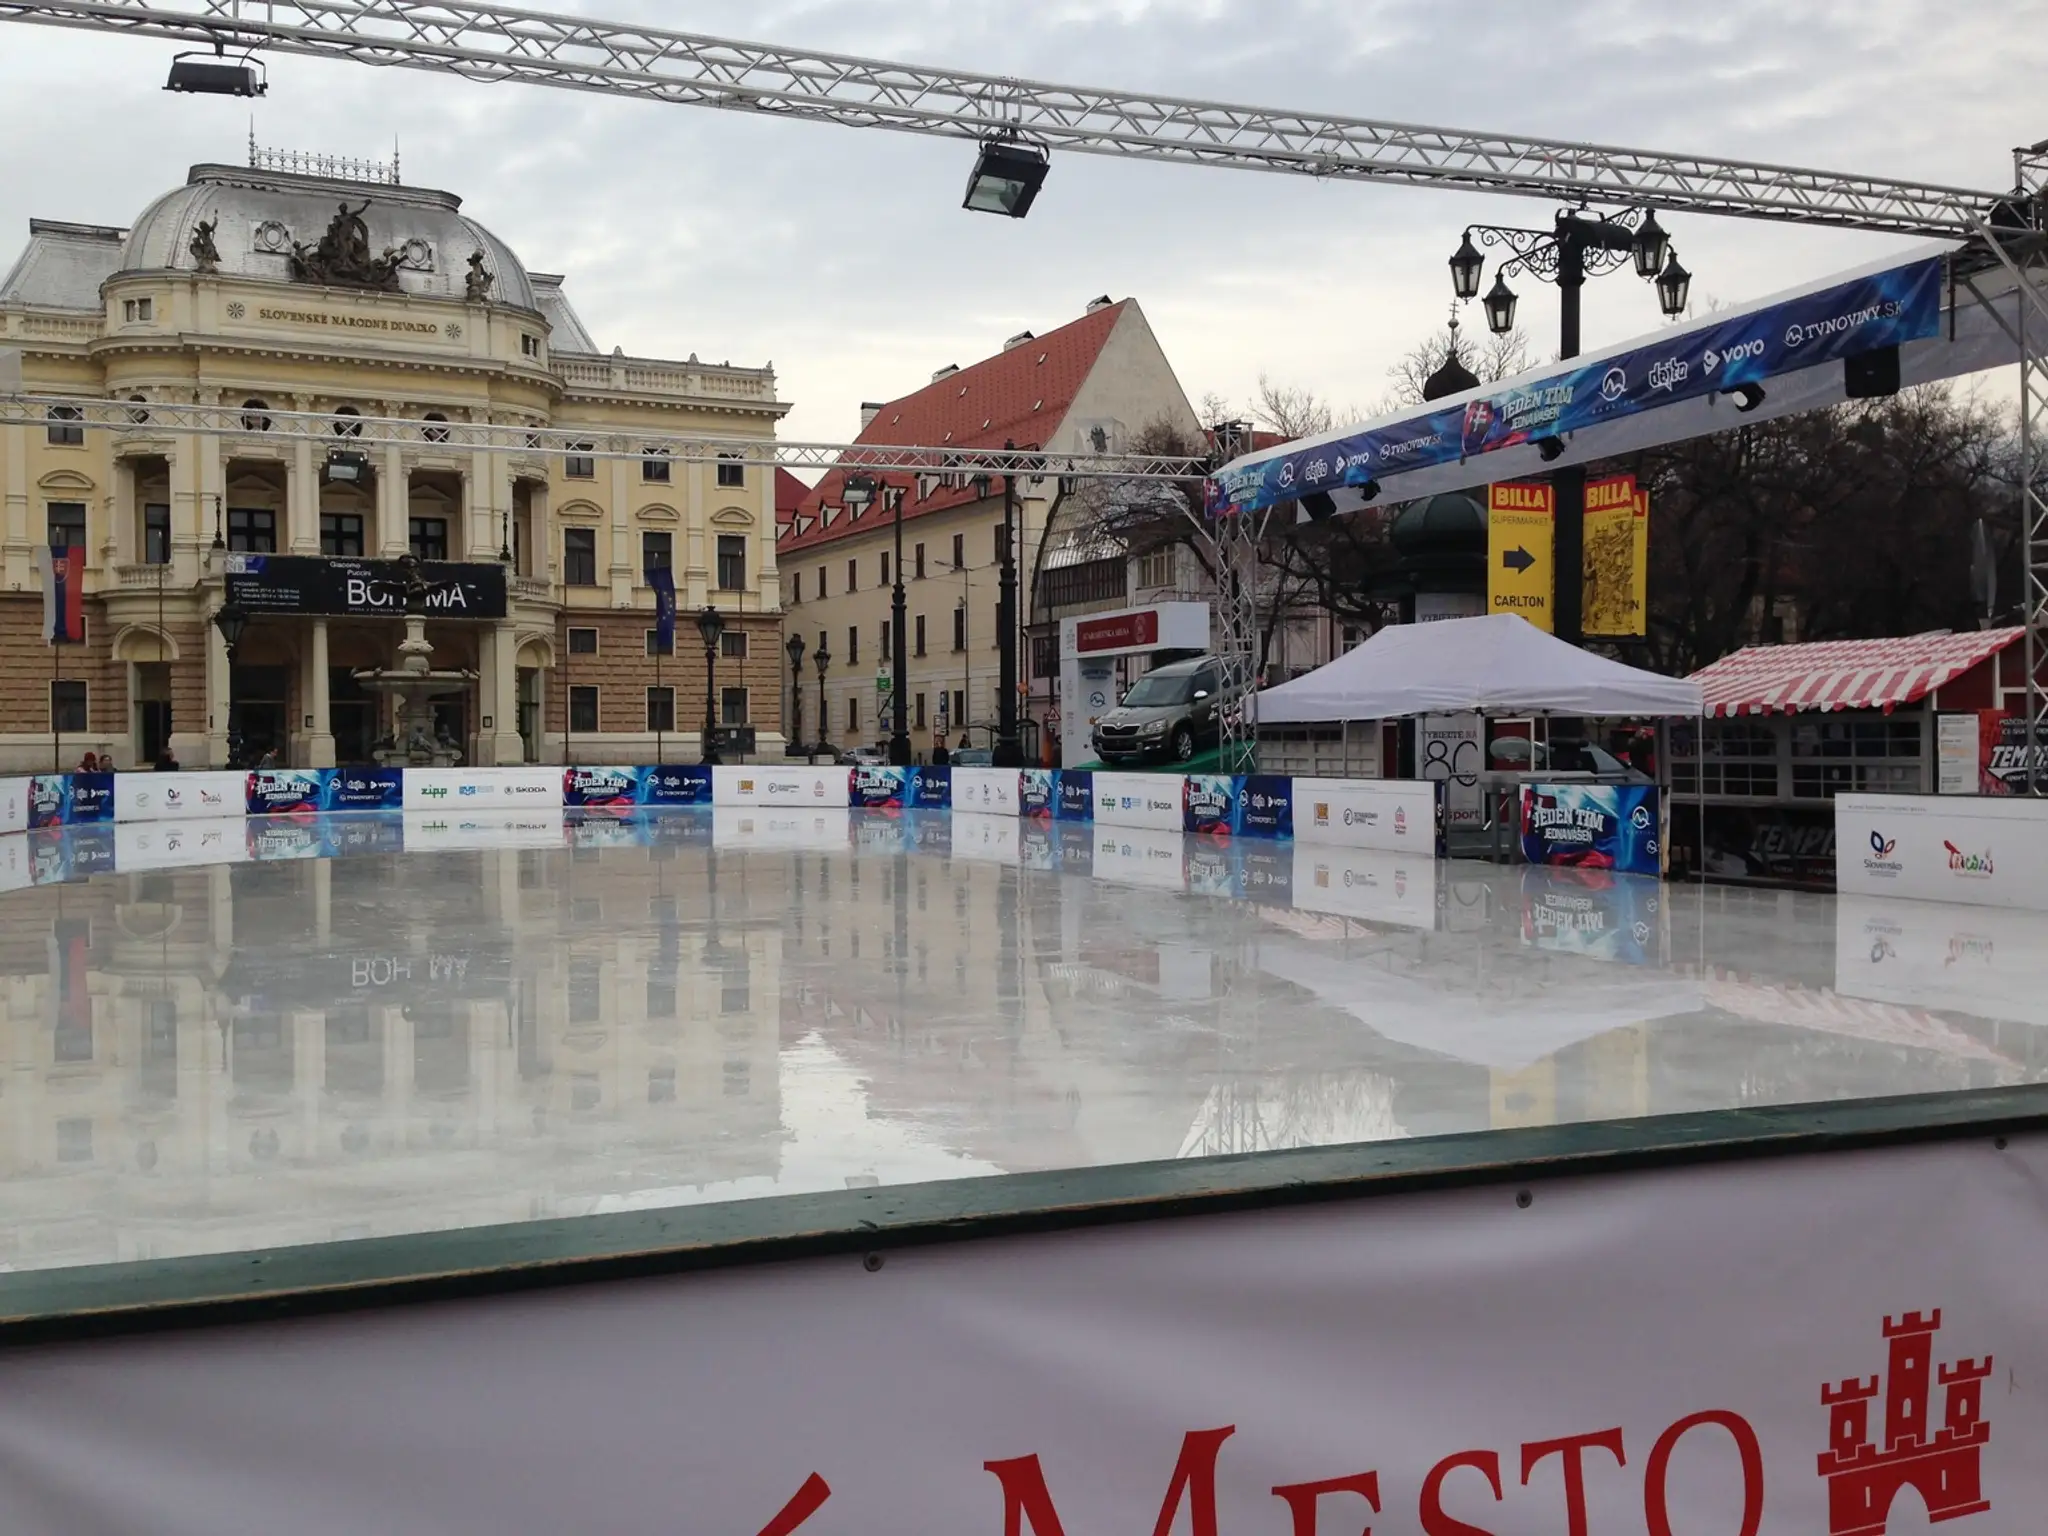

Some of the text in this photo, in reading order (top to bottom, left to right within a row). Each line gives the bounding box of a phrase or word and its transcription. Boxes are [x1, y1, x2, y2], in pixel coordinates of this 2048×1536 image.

[390, 320, 438, 334] DIVADLO
[1721, 338, 1765, 364] VOYO
[1502, 389, 1544, 424] JEDEN
[1347, 451, 1370, 468] VOYO
[1495, 487, 1546, 508] BILLA
[1586, 481, 1632, 508] BILLA
[1491, 514, 1549, 527] SUPERMARKET
[329, 560, 361, 569] Giacomo
[346, 568, 372, 577] Puccini
[1494, 594, 1545, 608] CARLTON
[421, 784, 448, 798] zipp
[1534, 804, 1573, 828] JEDEN
[983, 1410, 1764, 1536] MESTO
